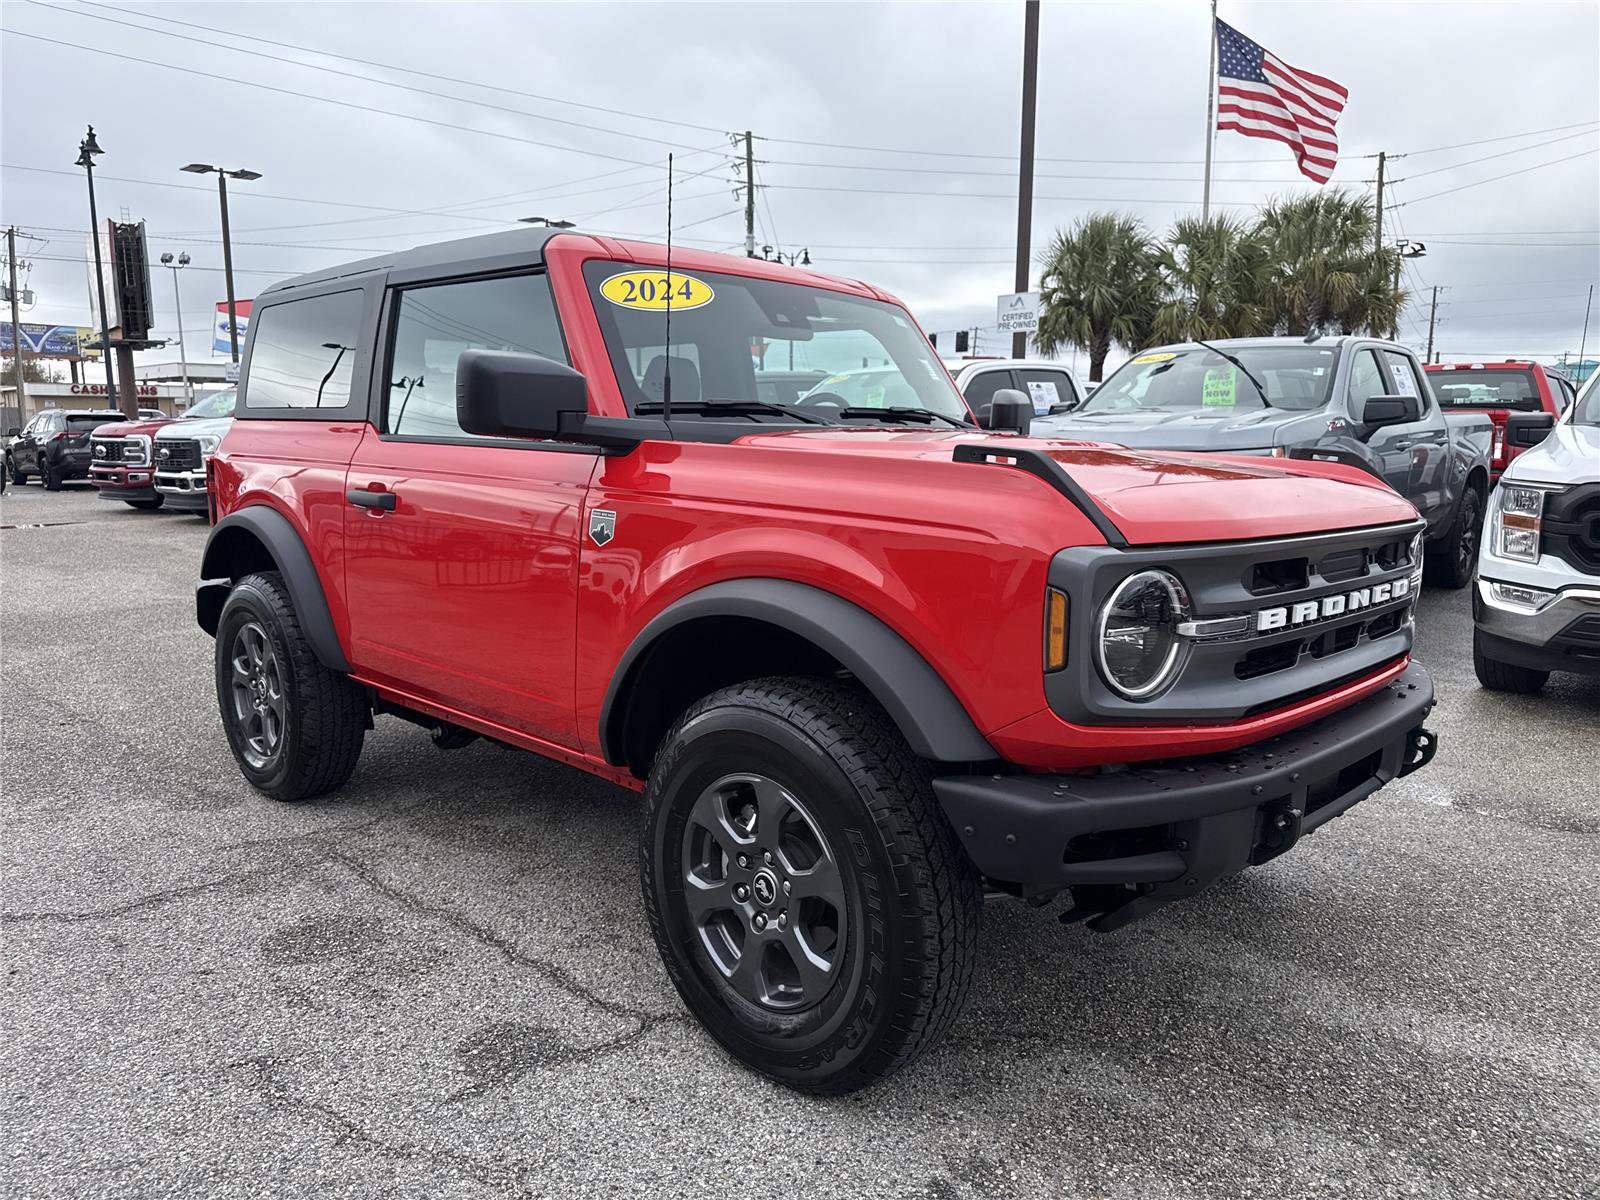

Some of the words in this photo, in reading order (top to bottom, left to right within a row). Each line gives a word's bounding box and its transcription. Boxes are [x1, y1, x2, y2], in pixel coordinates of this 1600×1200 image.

[621, 278, 692, 302] 2024
[1002, 312, 1034, 321] CERTIFIED
[998, 320, 1037, 330] PRE-OWNED
[71, 384, 108, 394] CASH
[1206, 390, 1231, 398] NOW
[1257, 577, 1410, 631] BRONCO
